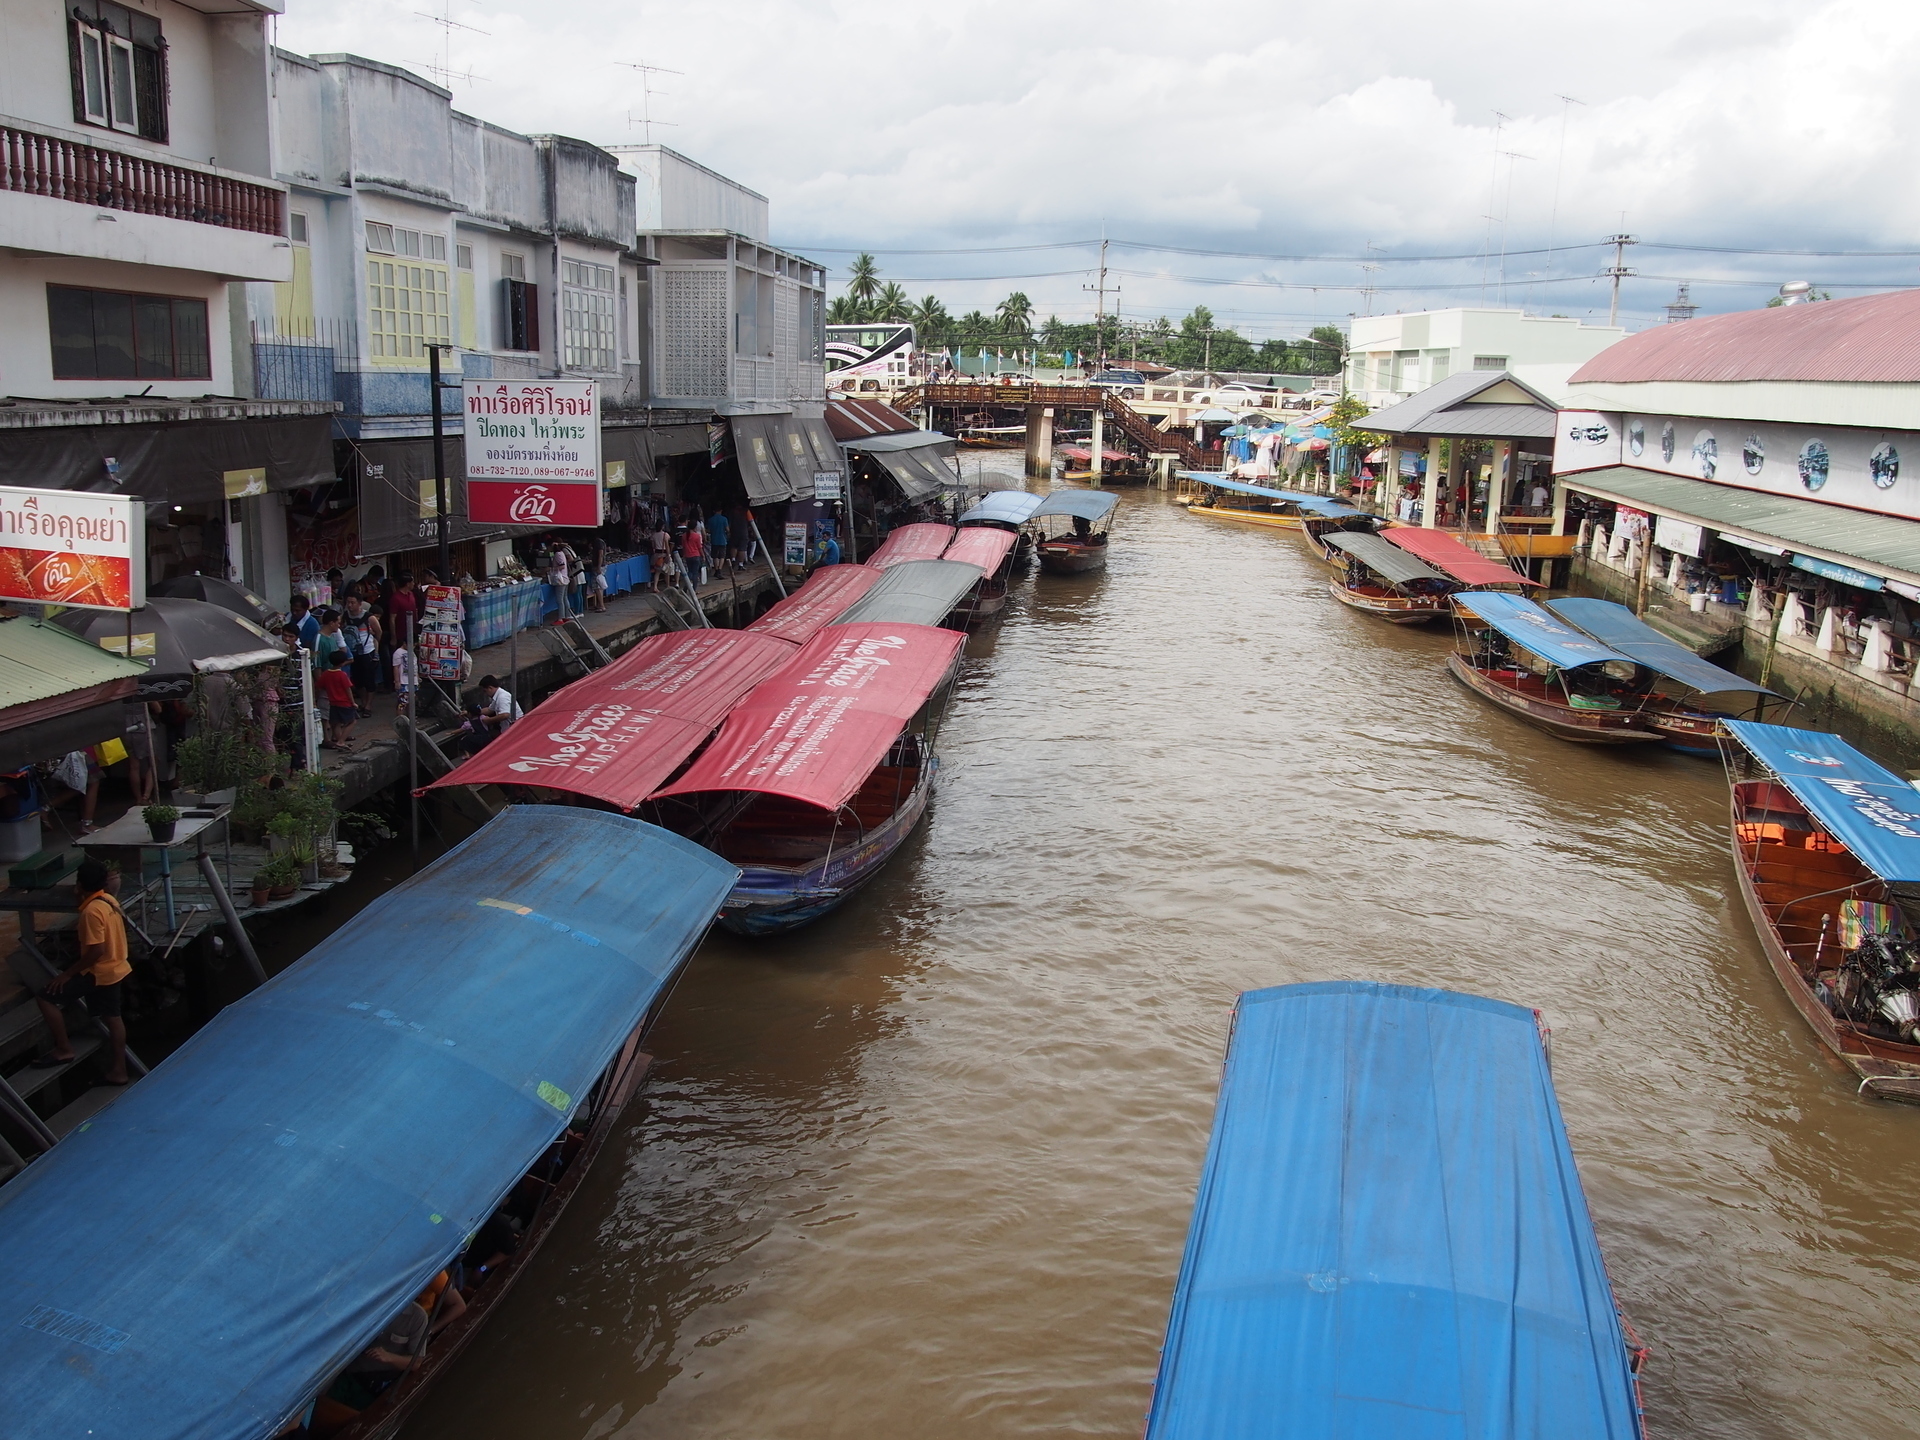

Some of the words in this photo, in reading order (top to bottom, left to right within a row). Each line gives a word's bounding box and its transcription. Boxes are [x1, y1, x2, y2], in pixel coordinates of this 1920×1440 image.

[468, 385, 592, 416] ท่าเรือศิริโรจน์
[477, 417, 525, 438] ปิดทอง
[531, 417, 585, 439] ไหว้พระ
[486, 441, 578, 462] จองบัตรชมหิ่งห้อย
[855, 636, 906, 656] The
[798, 638, 858, 686] AMPHAWA
[825, 656, 891, 688] Grace
[509, 743, 587, 773] The
[548, 703, 632, 744] Grace
[575, 708, 663, 774] AMPHAWA
